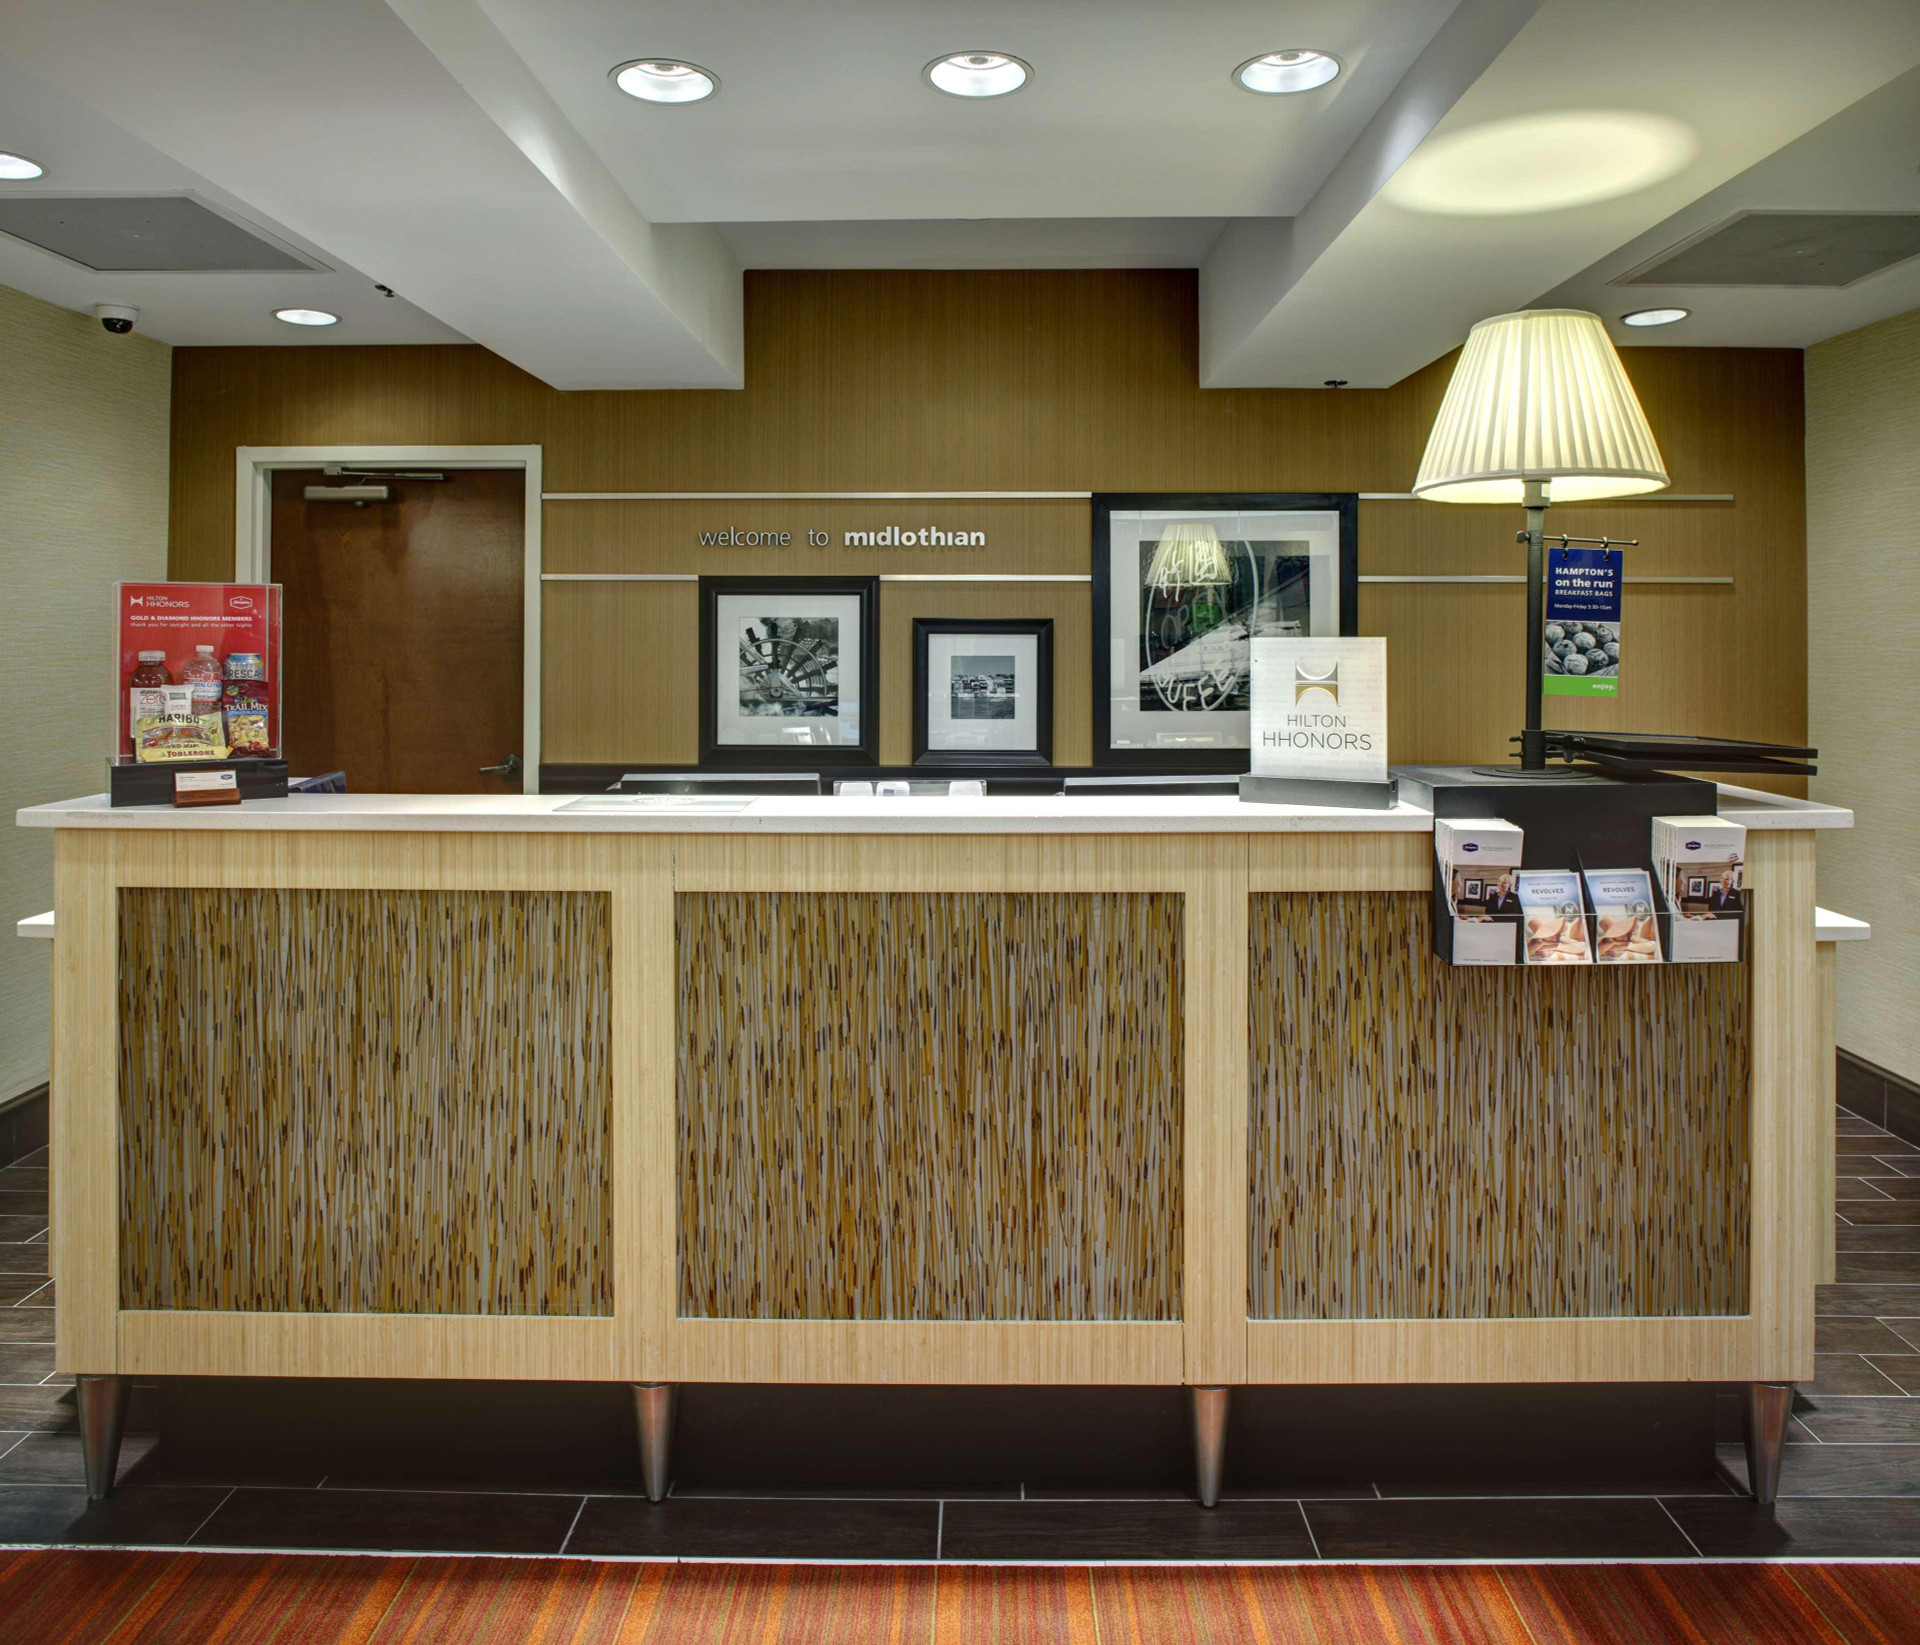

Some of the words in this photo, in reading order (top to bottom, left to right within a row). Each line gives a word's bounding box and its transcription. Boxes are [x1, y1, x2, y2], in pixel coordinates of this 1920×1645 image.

[698, 526, 791, 546] welcome
[808, 528, 829, 546] to
[844, 526, 986, 546] midlothian
[1555, 567, 1614, 577] HAMPTON'S
[1555, 579, 1570, 587] on
[1572, 578, 1591, 588] the
[1593, 580, 1613, 588] run
[140, 694, 166, 705] zero
[158, 713, 200, 724] HARIBO
[1287, 714, 1347, 728] HILTON
[1263, 731, 1372, 751] HHONORS
